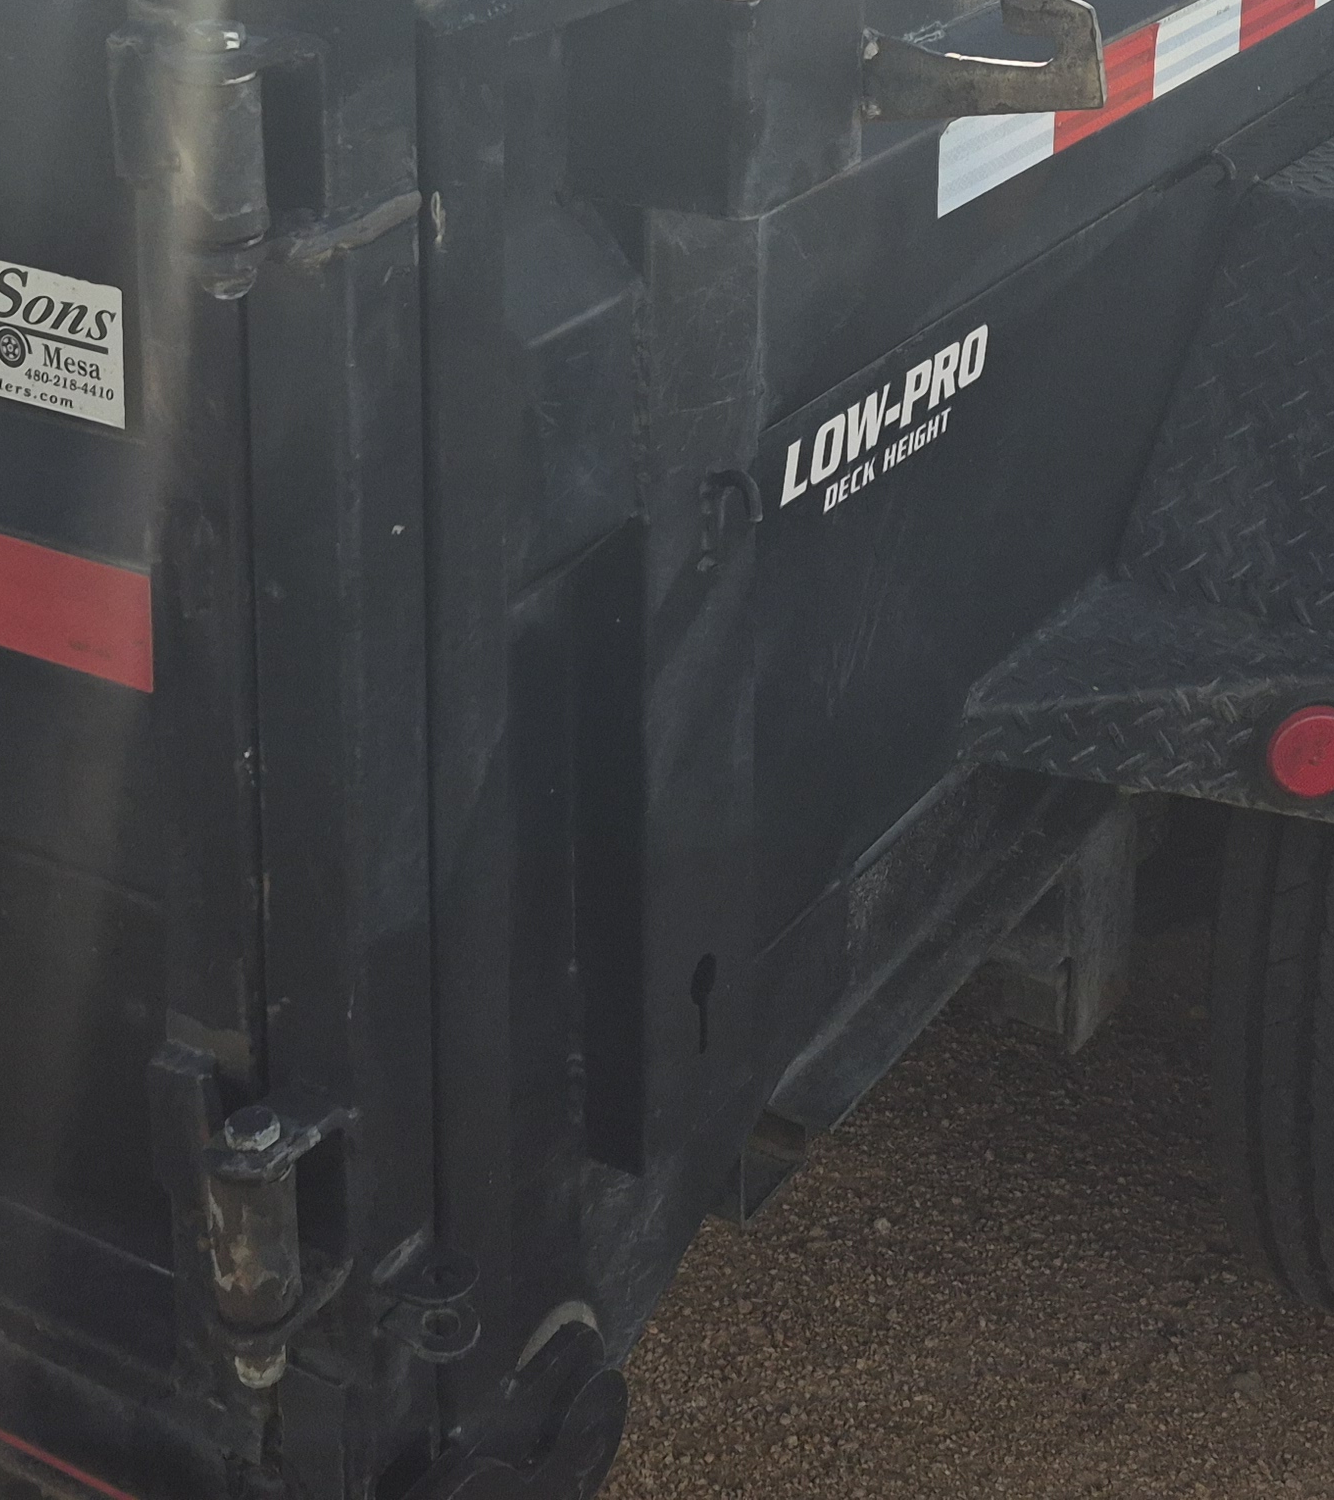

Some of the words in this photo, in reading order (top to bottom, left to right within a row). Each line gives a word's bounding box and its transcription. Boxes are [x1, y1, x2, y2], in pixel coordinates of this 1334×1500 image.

[24, 368, 115, 401] 480-218-4410
[42, 343, 102, 381] Mesa
[779, 323, 989, 509] LOW-PRO
[823, 456, 877, 515] DECK
[882, 406, 952, 474] HEIGHT
